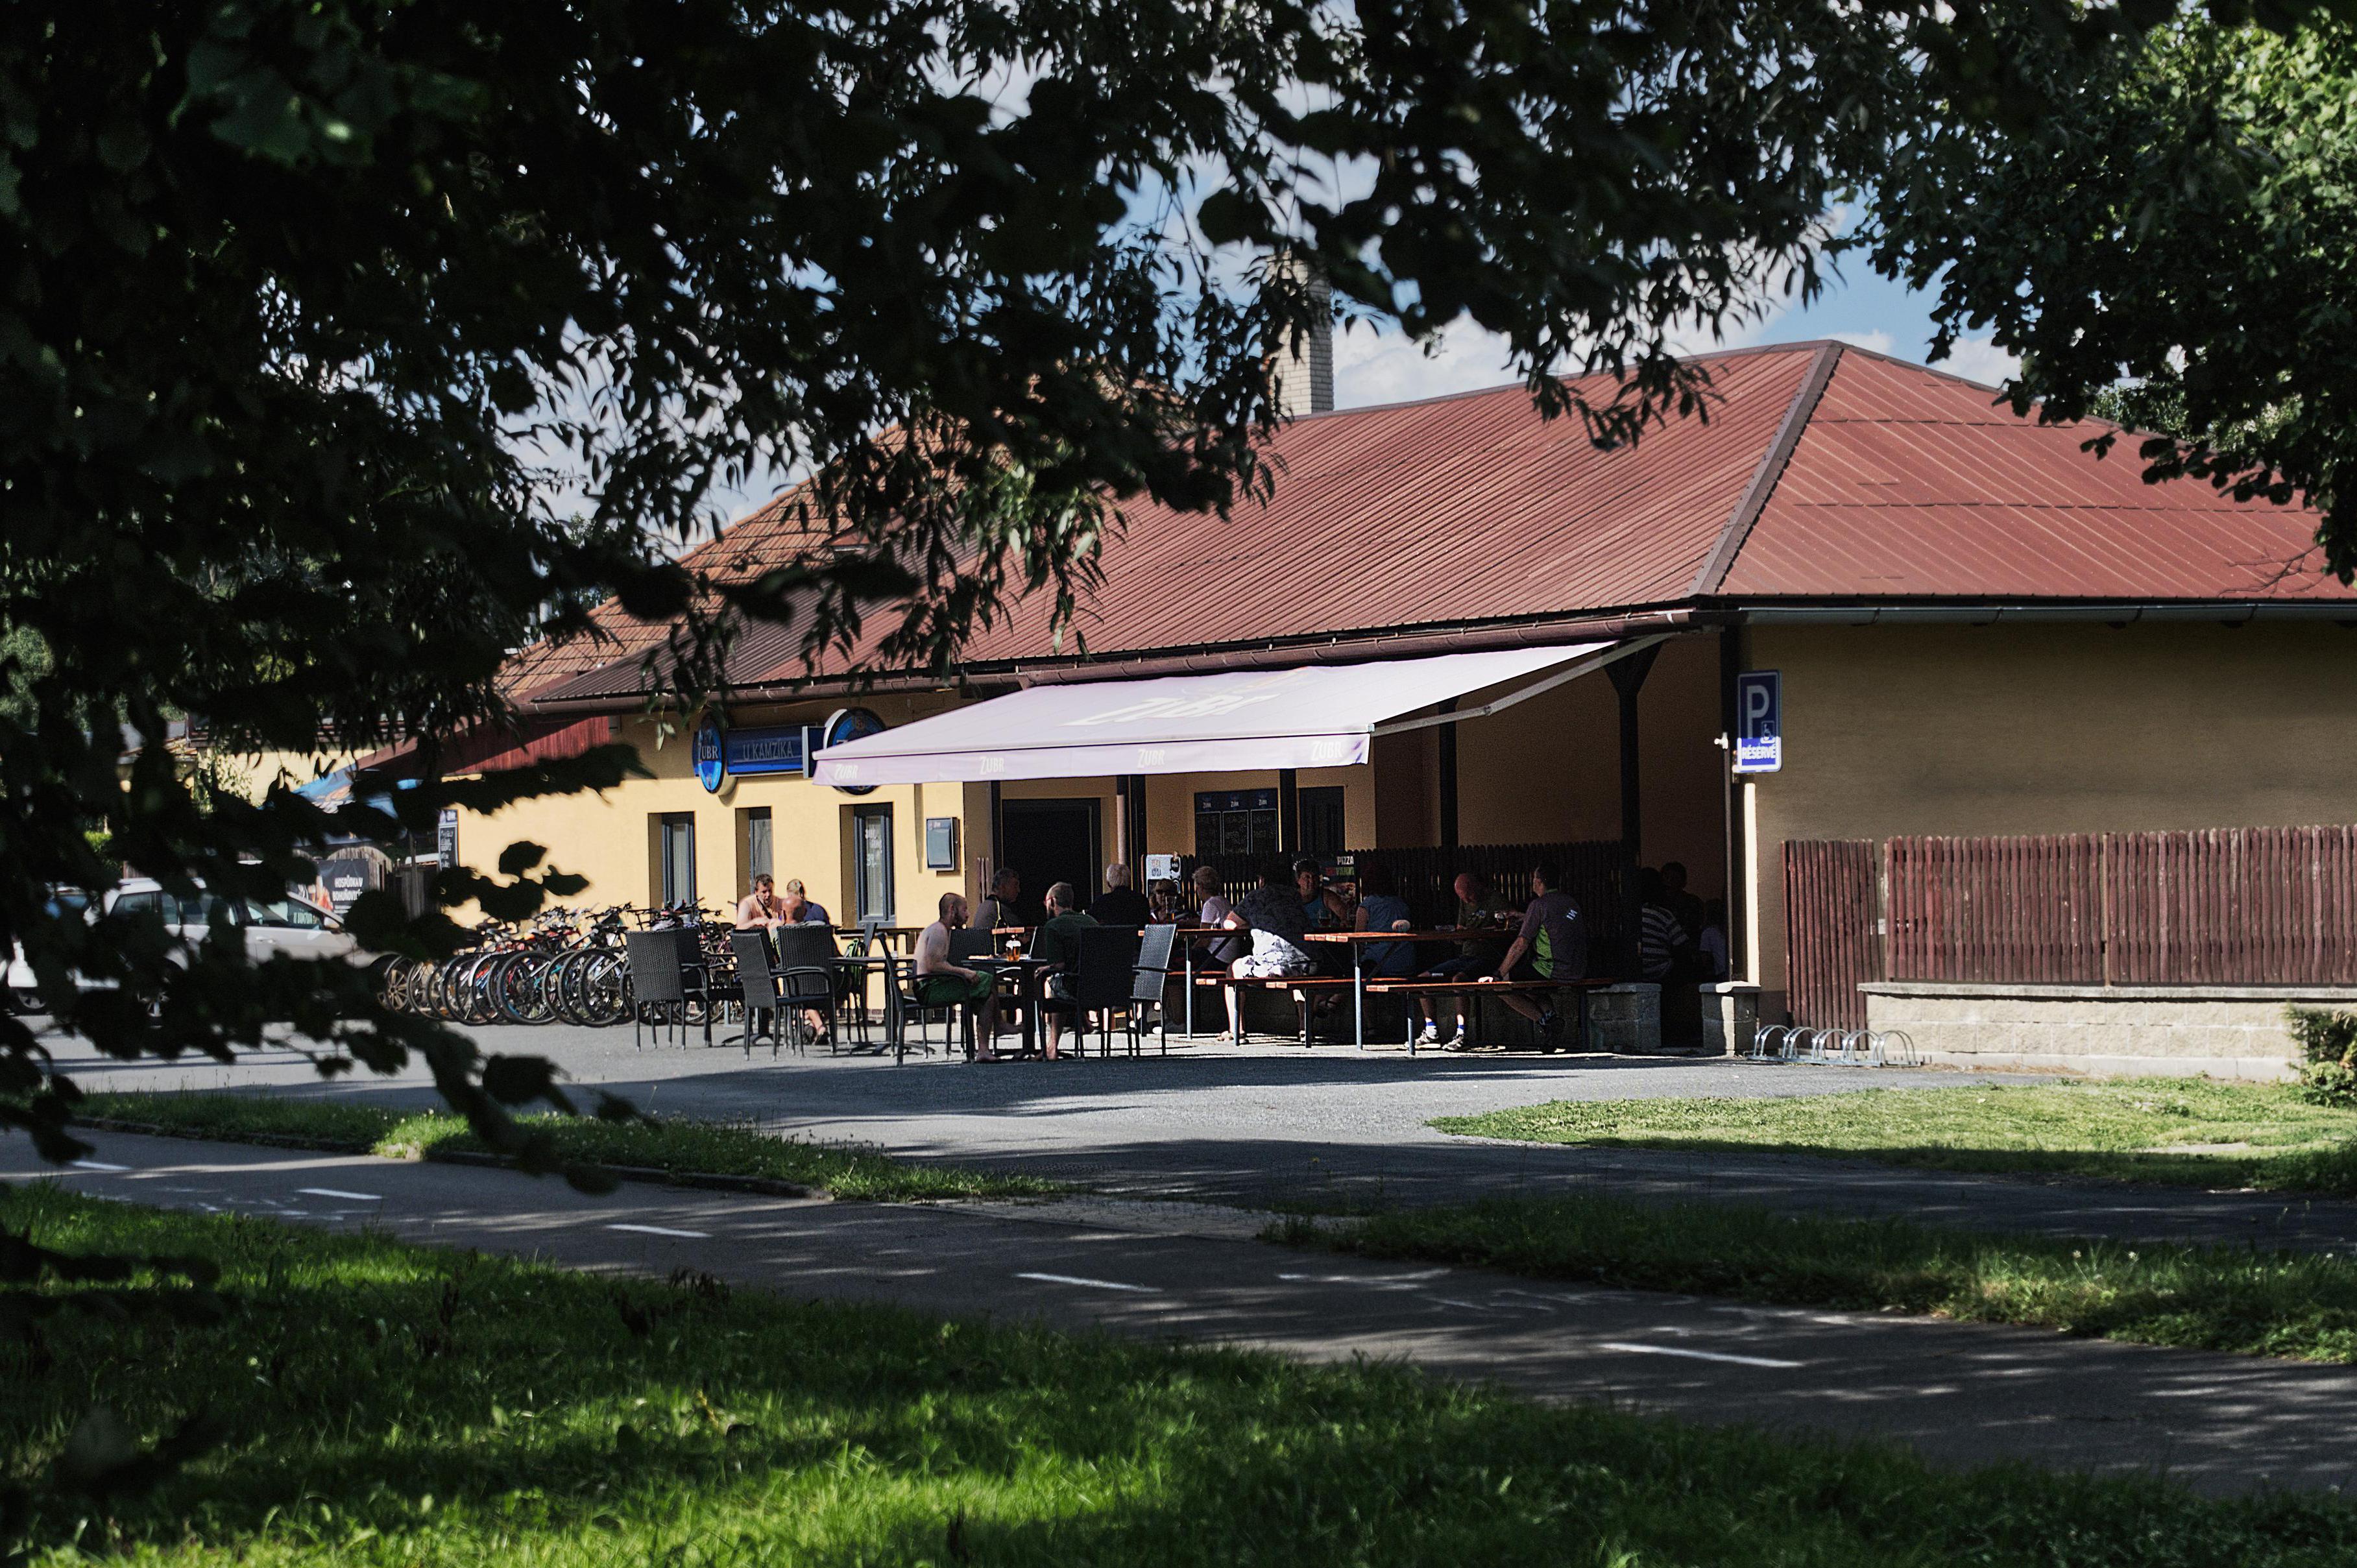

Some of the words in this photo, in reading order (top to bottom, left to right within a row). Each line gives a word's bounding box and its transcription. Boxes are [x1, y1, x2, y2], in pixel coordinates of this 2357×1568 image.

[1747, 685, 1769, 739] P
[743, 744, 749, 760] U
[753, 738, 793, 760] KAMZÍKA
[1137, 749, 1165, 768] ZUBR
[1311, 741, 1343, 760] ZUBR
[834, 764, 858, 779] ZUBR
[980, 756, 1005, 775] ZUBR
[1337, 856, 1354, 865] PIZZA
